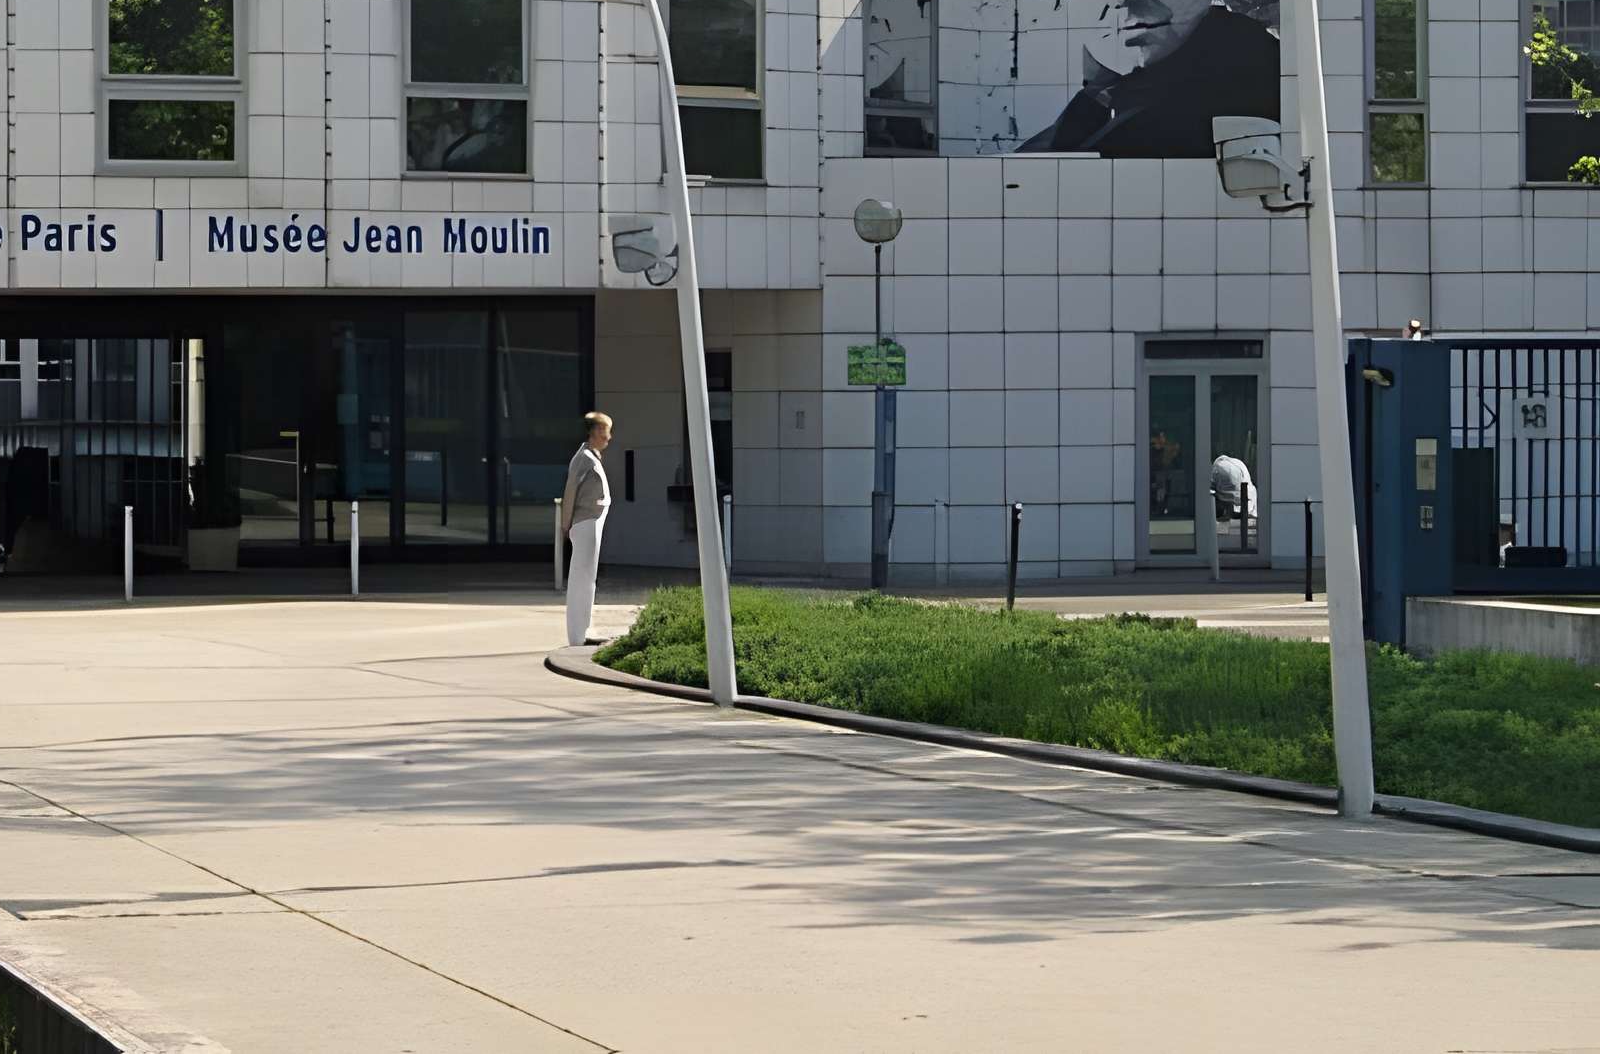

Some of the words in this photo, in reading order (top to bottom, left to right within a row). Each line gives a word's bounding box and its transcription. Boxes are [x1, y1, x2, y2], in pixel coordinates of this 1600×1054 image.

[21, 214, 117, 253] Paris
[208, 213, 327, 253] Musée
[342, 216, 423, 253] Jean
[443, 217, 549, 254] Moulin
